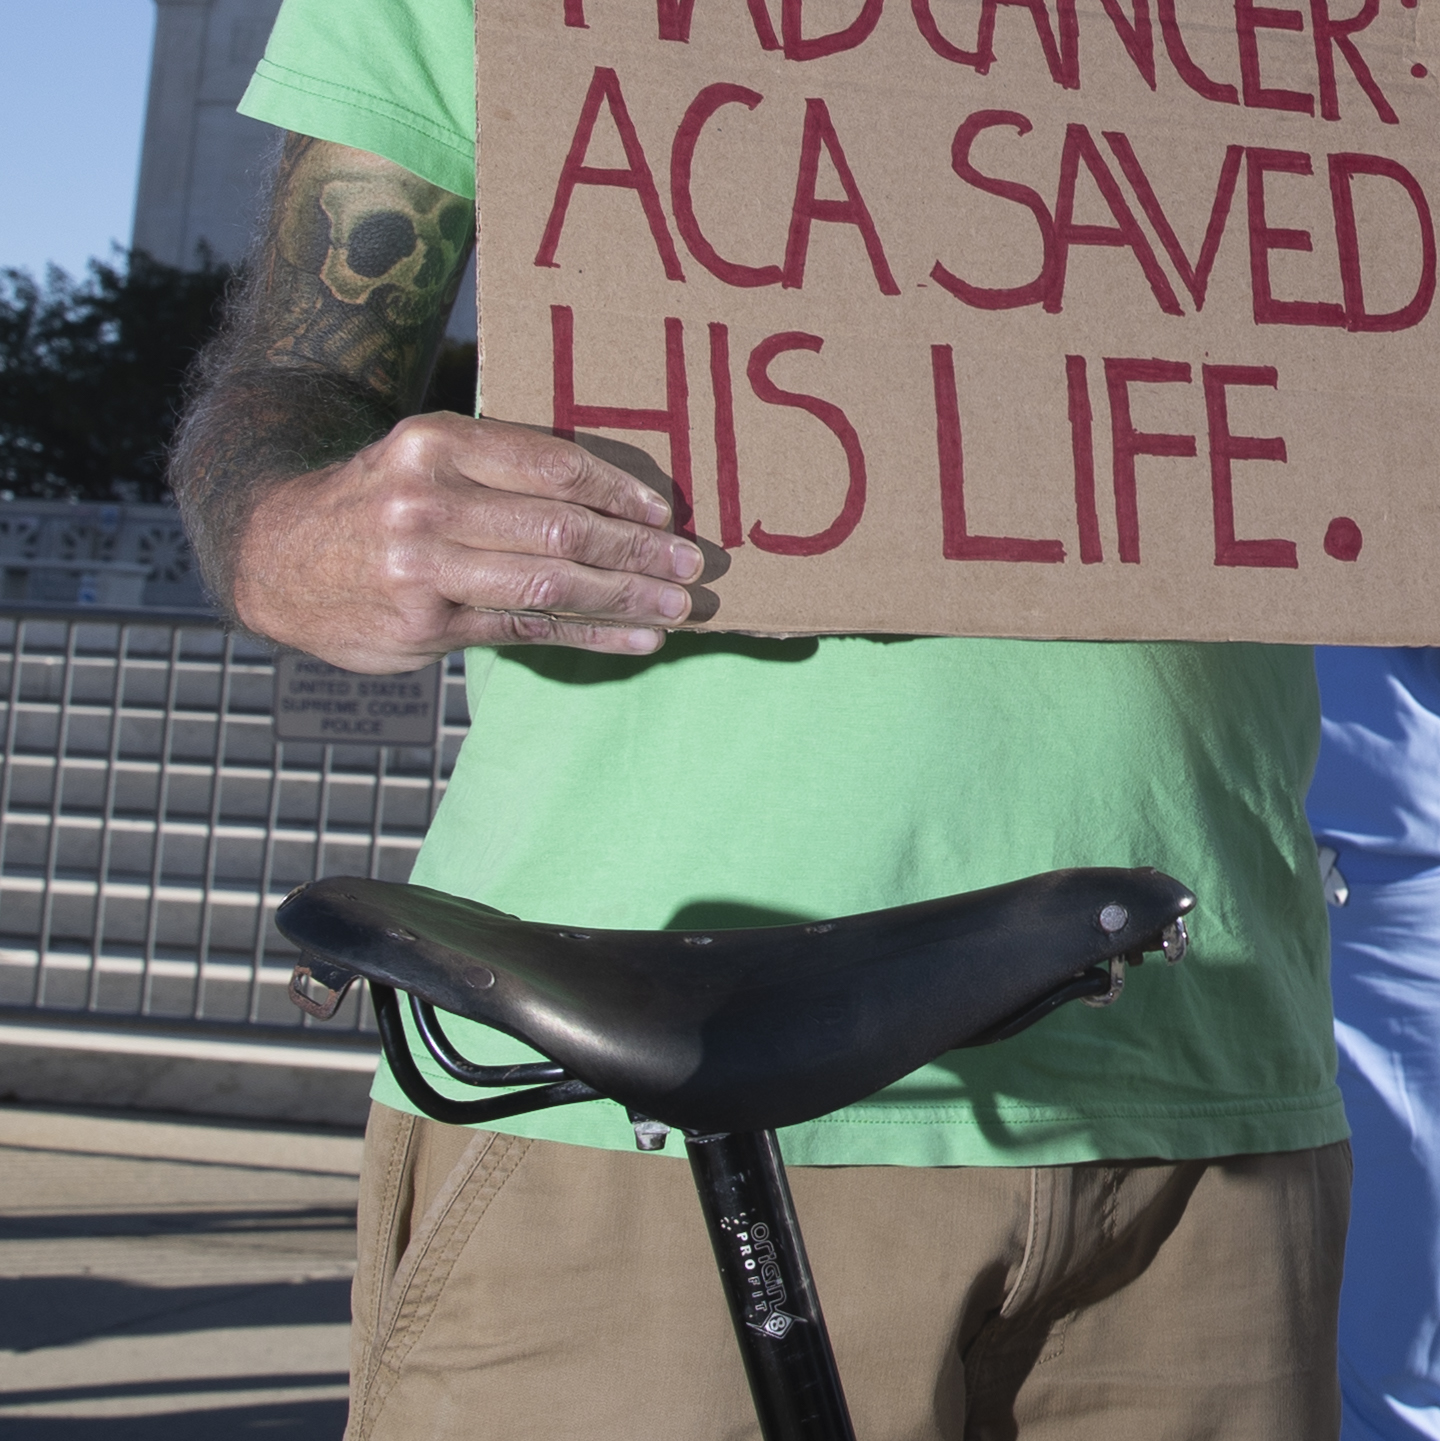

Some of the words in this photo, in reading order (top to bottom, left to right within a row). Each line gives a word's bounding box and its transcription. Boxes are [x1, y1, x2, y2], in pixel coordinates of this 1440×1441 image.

[534, 65, 900, 296] ACA
[929, 109, 1437, 332] SAVED
[549, 305, 866, 556] HIS
[930, 343, 1362, 568] LIFE.
[282, 697, 358, 713] SUPREME
[368, 700, 429, 717] COURT
[321, 717, 383, 734] POLICE
